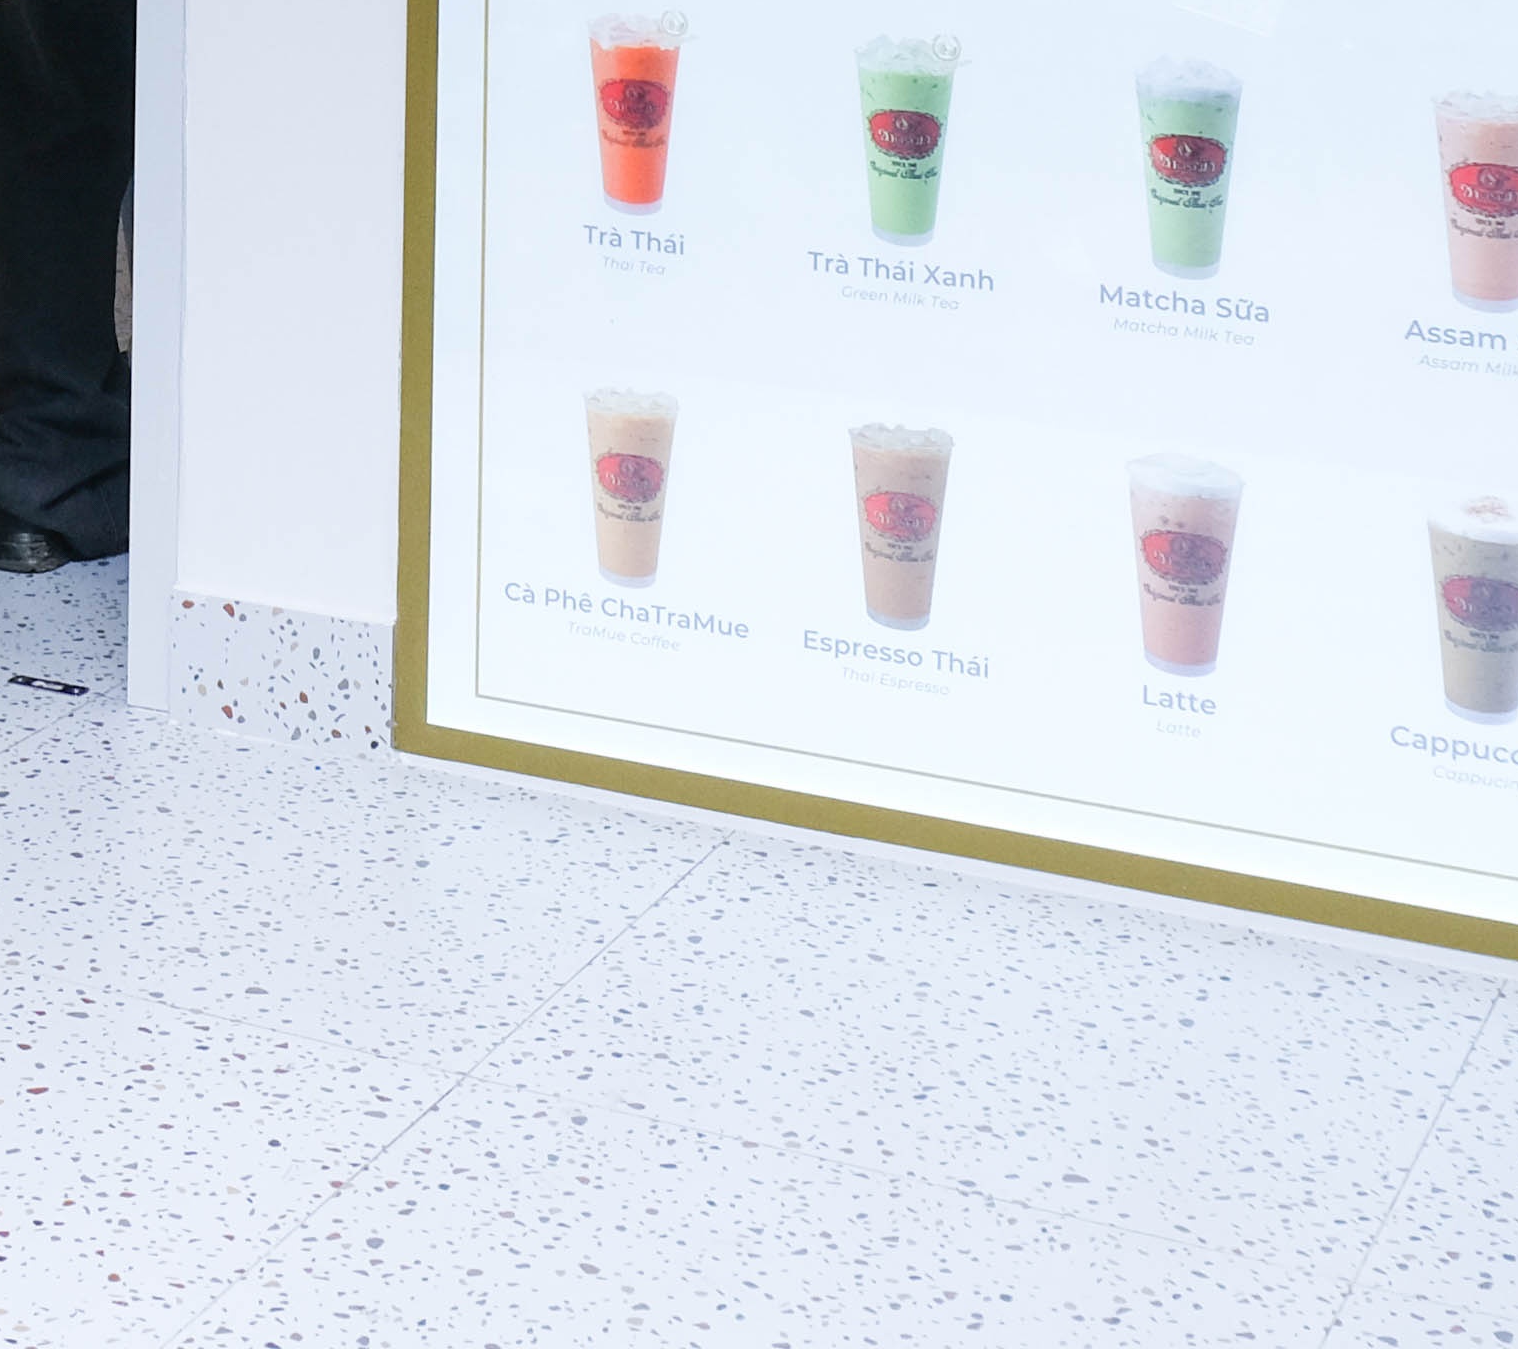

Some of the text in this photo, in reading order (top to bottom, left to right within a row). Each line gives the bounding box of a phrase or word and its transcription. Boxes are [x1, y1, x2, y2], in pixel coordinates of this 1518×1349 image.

[582, 224, 686, 256] Trà Thái
[807, 251, 995, 292] Trà Thái Xanh
[1099, 283, 1271, 324] Matcha Sữa
[1112, 316, 1179, 338] Matcha
[1183, 323, 1219, 343] Milk
[1404, 318, 1508, 353] Assam
[1417, 354, 1480, 375] Assam
[503, 582, 751, 639] Cà Phê ChaTraMue
[803, 629, 990, 680] Espresso Thái
[1141, 683, 1218, 717] Latte
